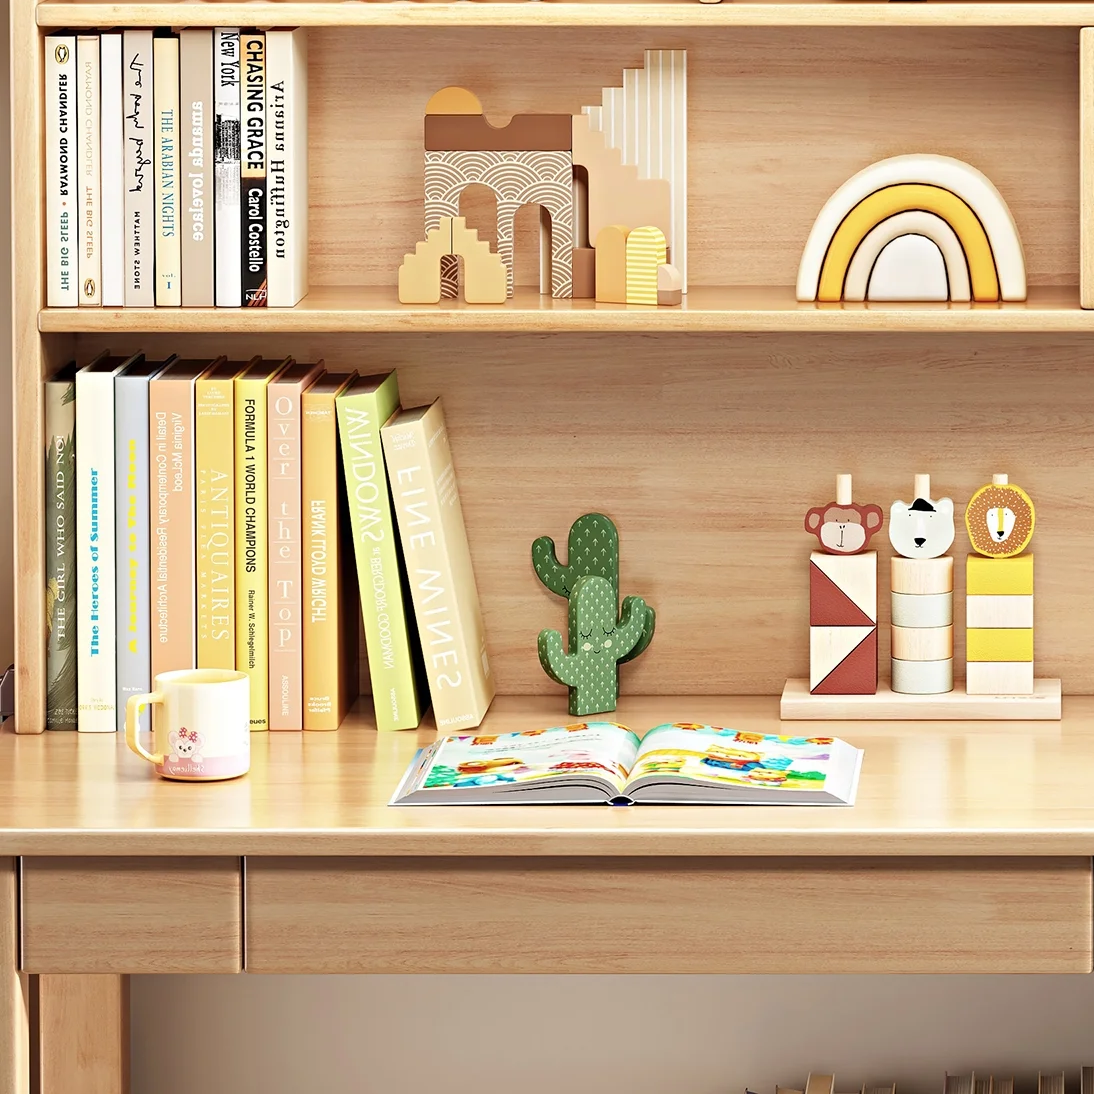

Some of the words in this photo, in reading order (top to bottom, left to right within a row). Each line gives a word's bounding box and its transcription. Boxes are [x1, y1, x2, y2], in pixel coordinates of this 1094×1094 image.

[221, 32, 240, 57] New
[221, 60, 240, 87] York
[246, 40, 263, 112] CHASING
[161, 109, 173, 132] THE
[161, 137, 174, 188] ARABIAN
[247, 117, 264, 169] GRACE
[162, 193, 175, 237] NIGHTS
[248, 188, 263, 220] Carol
[248, 224, 263, 272] Costello
[245, 399, 255, 453] FORMULA
[274, 396, 293, 475] Over
[56, 435, 65, 465] NO!
[127, 439, 137, 490] Moon
[56, 471, 65, 510] SAID
[90, 467, 99, 542] Summer
[245, 464, 256, 505] WORLD
[127, 494, 137, 529] The
[278, 501, 291, 558] the
[56, 514, 65, 557] WHO
[90, 545, 99, 562] of
[128, 533, 137, 552] to
[207, 469, 230, 641] ANTIQUAIRES
[245, 507, 257, 573] CHAMPIONS
[57, 562, 66, 602] GIRL
[90, 566, 99, 621] Heroes
[128, 558, 138, 633] Journey
[248, 589, 256, 611] Rainer
[57, 607, 66, 641] THE
[248, 613, 256, 622] W.
[276, 580, 293, 648] Top
[91, 625, 99, 657] The
[128, 639, 137, 654] A
[247, 623, 256, 669] Schlegelmilch
[281, 674, 289, 716] ASSOULINE
